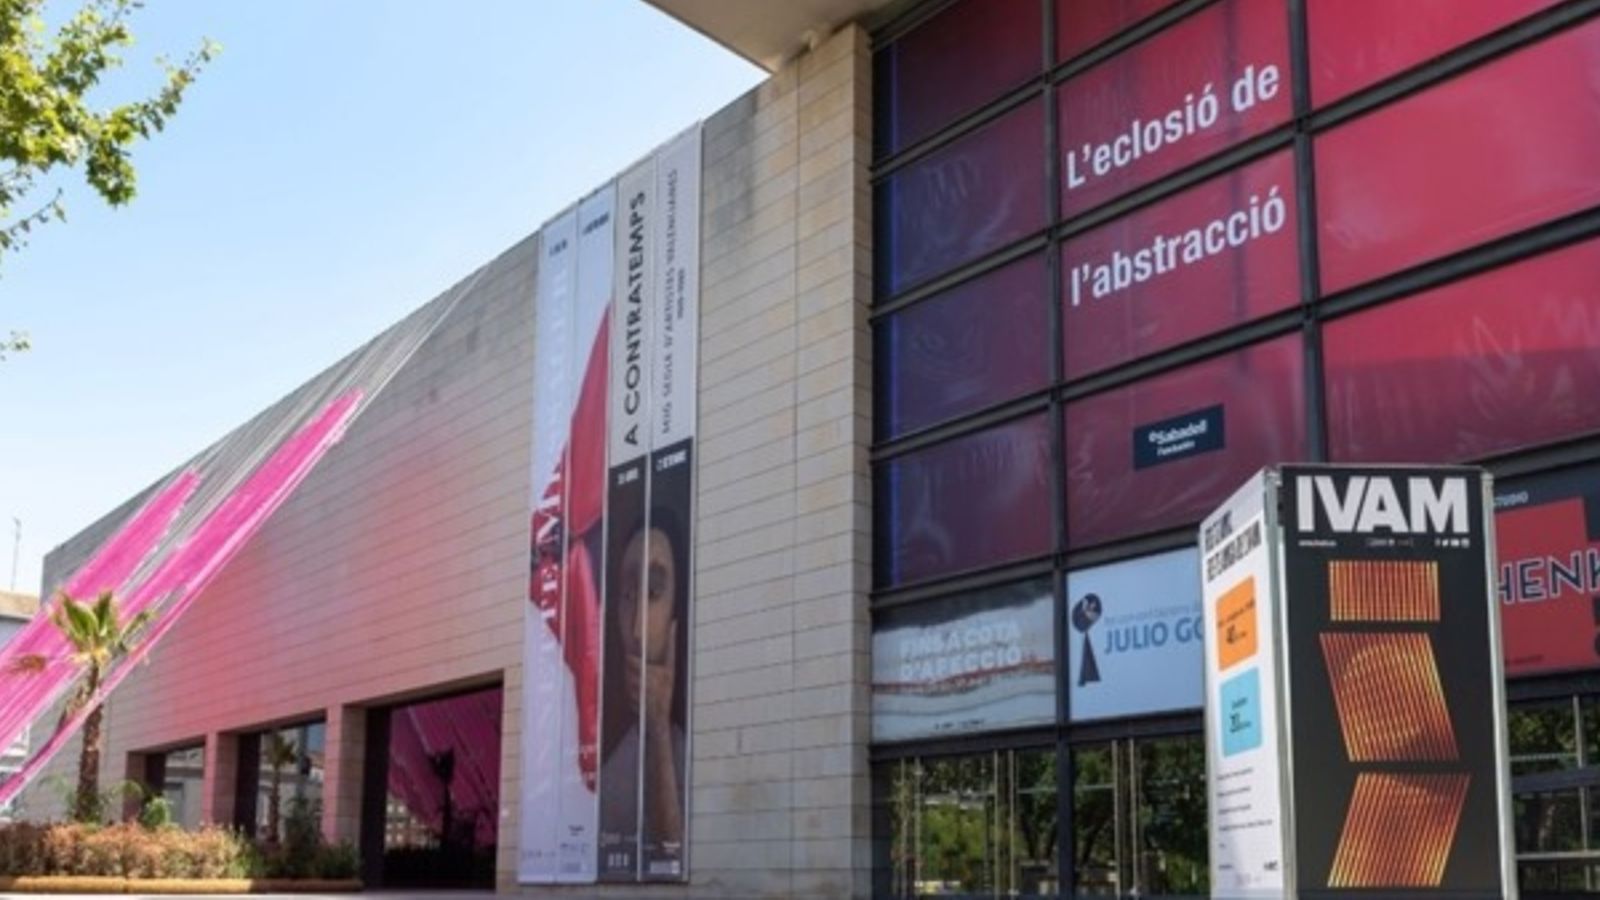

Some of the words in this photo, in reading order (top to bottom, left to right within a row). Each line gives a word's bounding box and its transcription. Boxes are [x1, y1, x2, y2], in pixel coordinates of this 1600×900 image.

[1067, 84, 1218, 189] L'eclosió
[1231, 64, 1280, 112] de
[1071, 185, 1285, 306] l'abstracció
[623, 191, 646, 416] CONTRATEMPS
[623, 424, 639, 446] A
[1296, 475, 1470, 535] IVAM
[1104, 620, 1168, 656] JULIO
